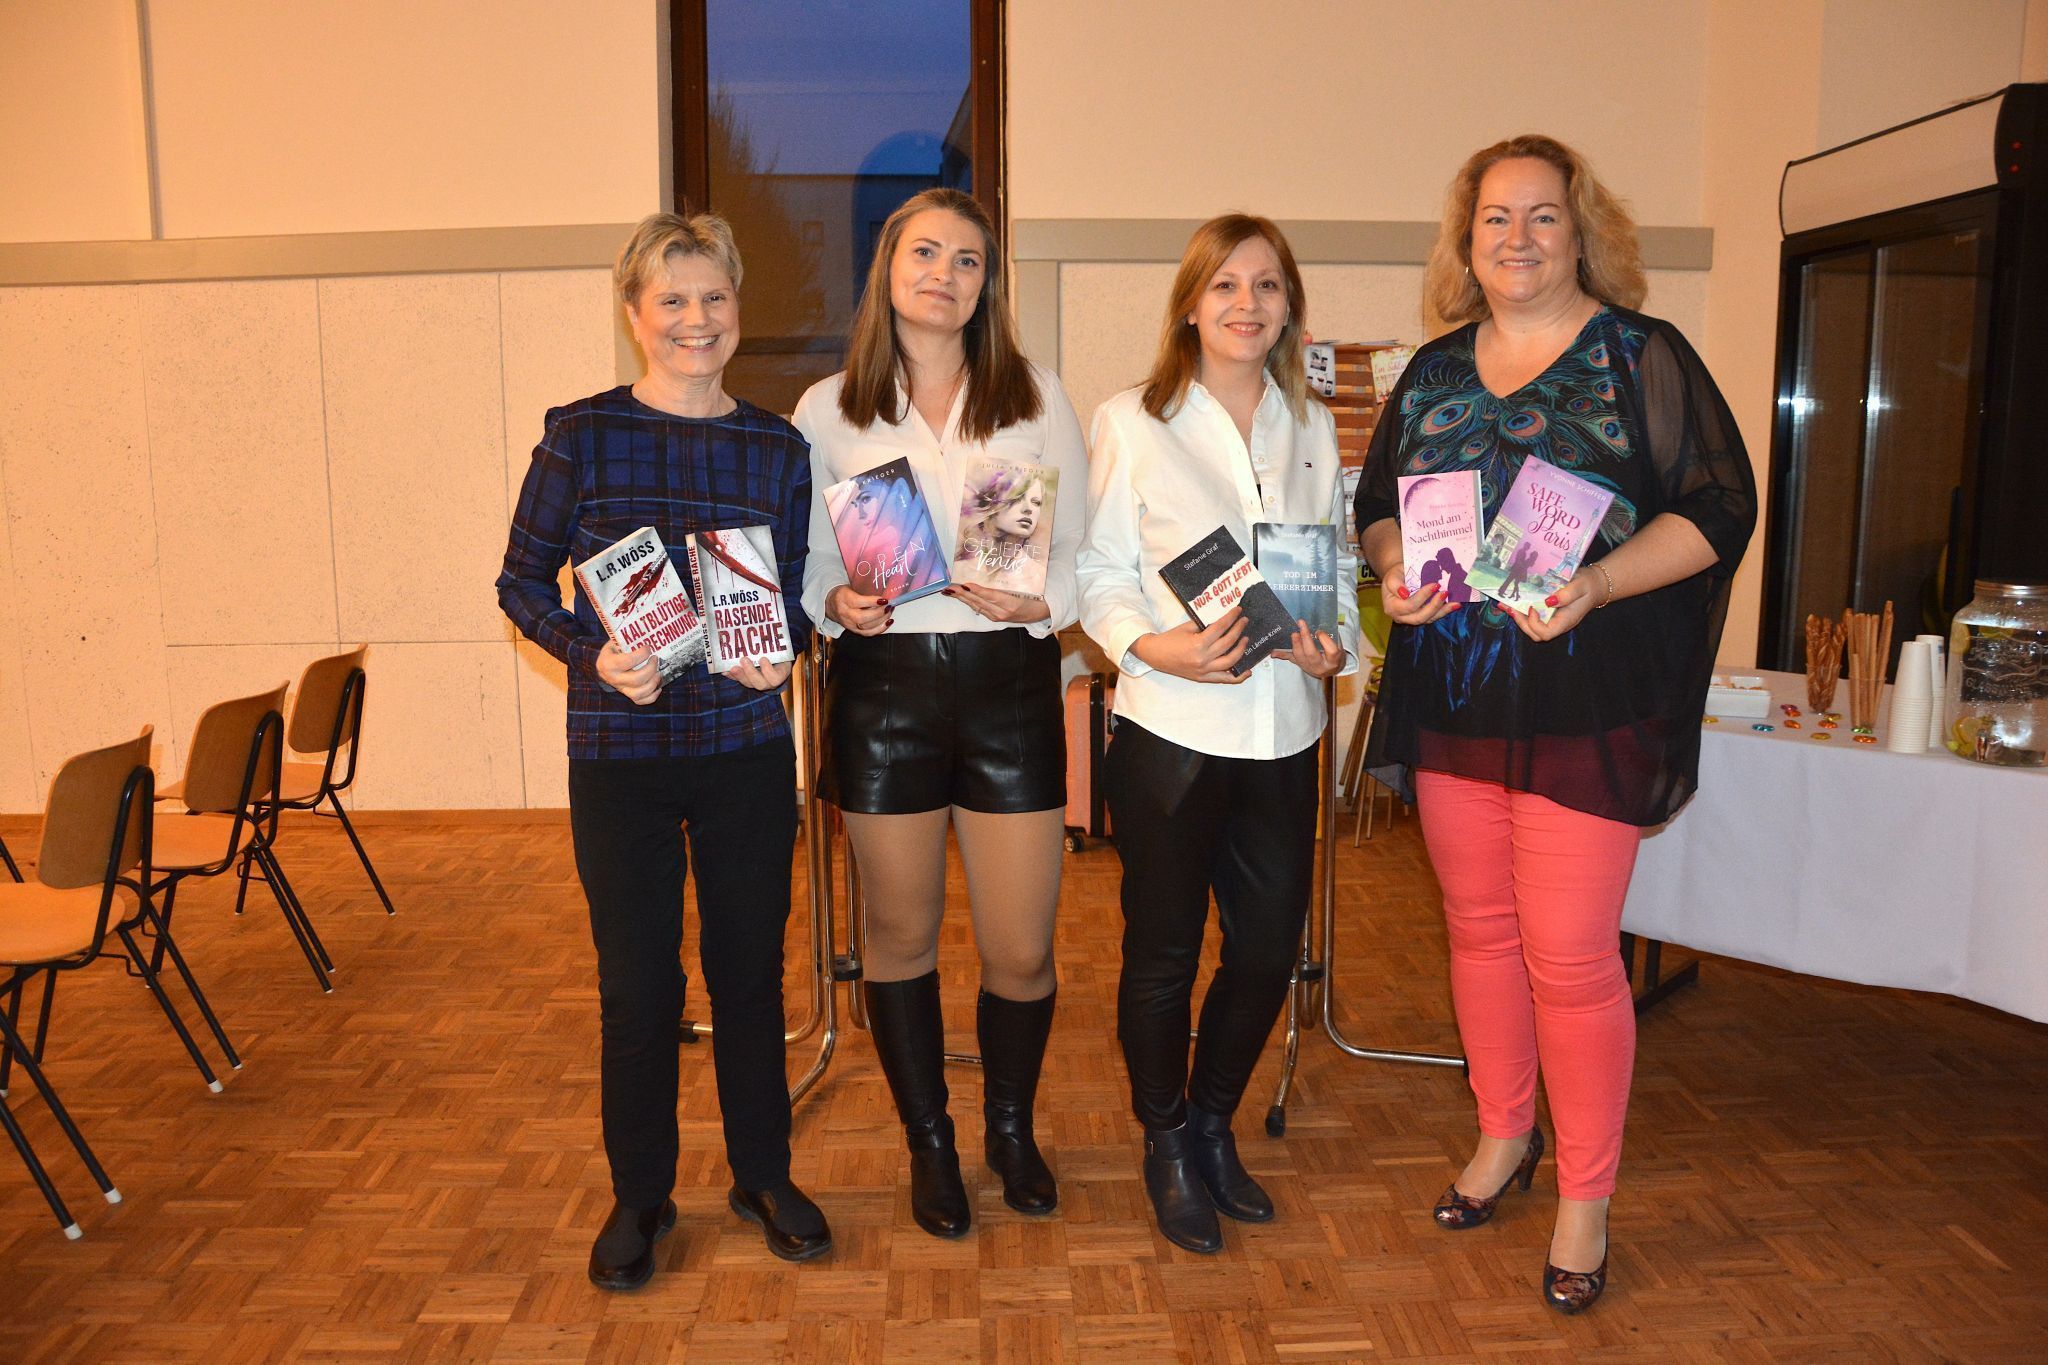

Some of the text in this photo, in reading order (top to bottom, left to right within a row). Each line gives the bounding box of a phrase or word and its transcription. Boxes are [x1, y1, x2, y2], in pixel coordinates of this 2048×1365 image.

[1528, 482, 1566, 508] SAFE
[1550, 471, 1607, 501] YVONNE SCHIFFER
[1417, 514, 1461, 529] Mond am
[1532, 497, 1581, 529] WORD
[1407, 522, 1473, 545] Nachthimmel
[1528, 515, 1570, 551] Paris
[688, 545, 700, 576] RACHE
[856, 536, 926, 577] OPEN
[963, 537, 1042, 562] GELIEBTE
[974, 547, 1028, 577] Venus
[1183, 542, 1219, 571] Stefanie Graf
[872, 549, 917, 590] Heart
[1282, 570, 1318, 579] TOD IM
[693, 576, 706, 617] RASENDE
[1193, 561, 1253, 610] NUR GOTT LEBT
[1219, 586, 1242, 608] EWIG
[1271, 583, 1335, 592] EHRERZIMMER
[620, 592, 690, 645] KALTBLÜTIGE
[714, 602, 775, 630] RASENDE
[631, 610, 699, 653] RECHNUNG
[717, 621, 788, 661] RACHE
